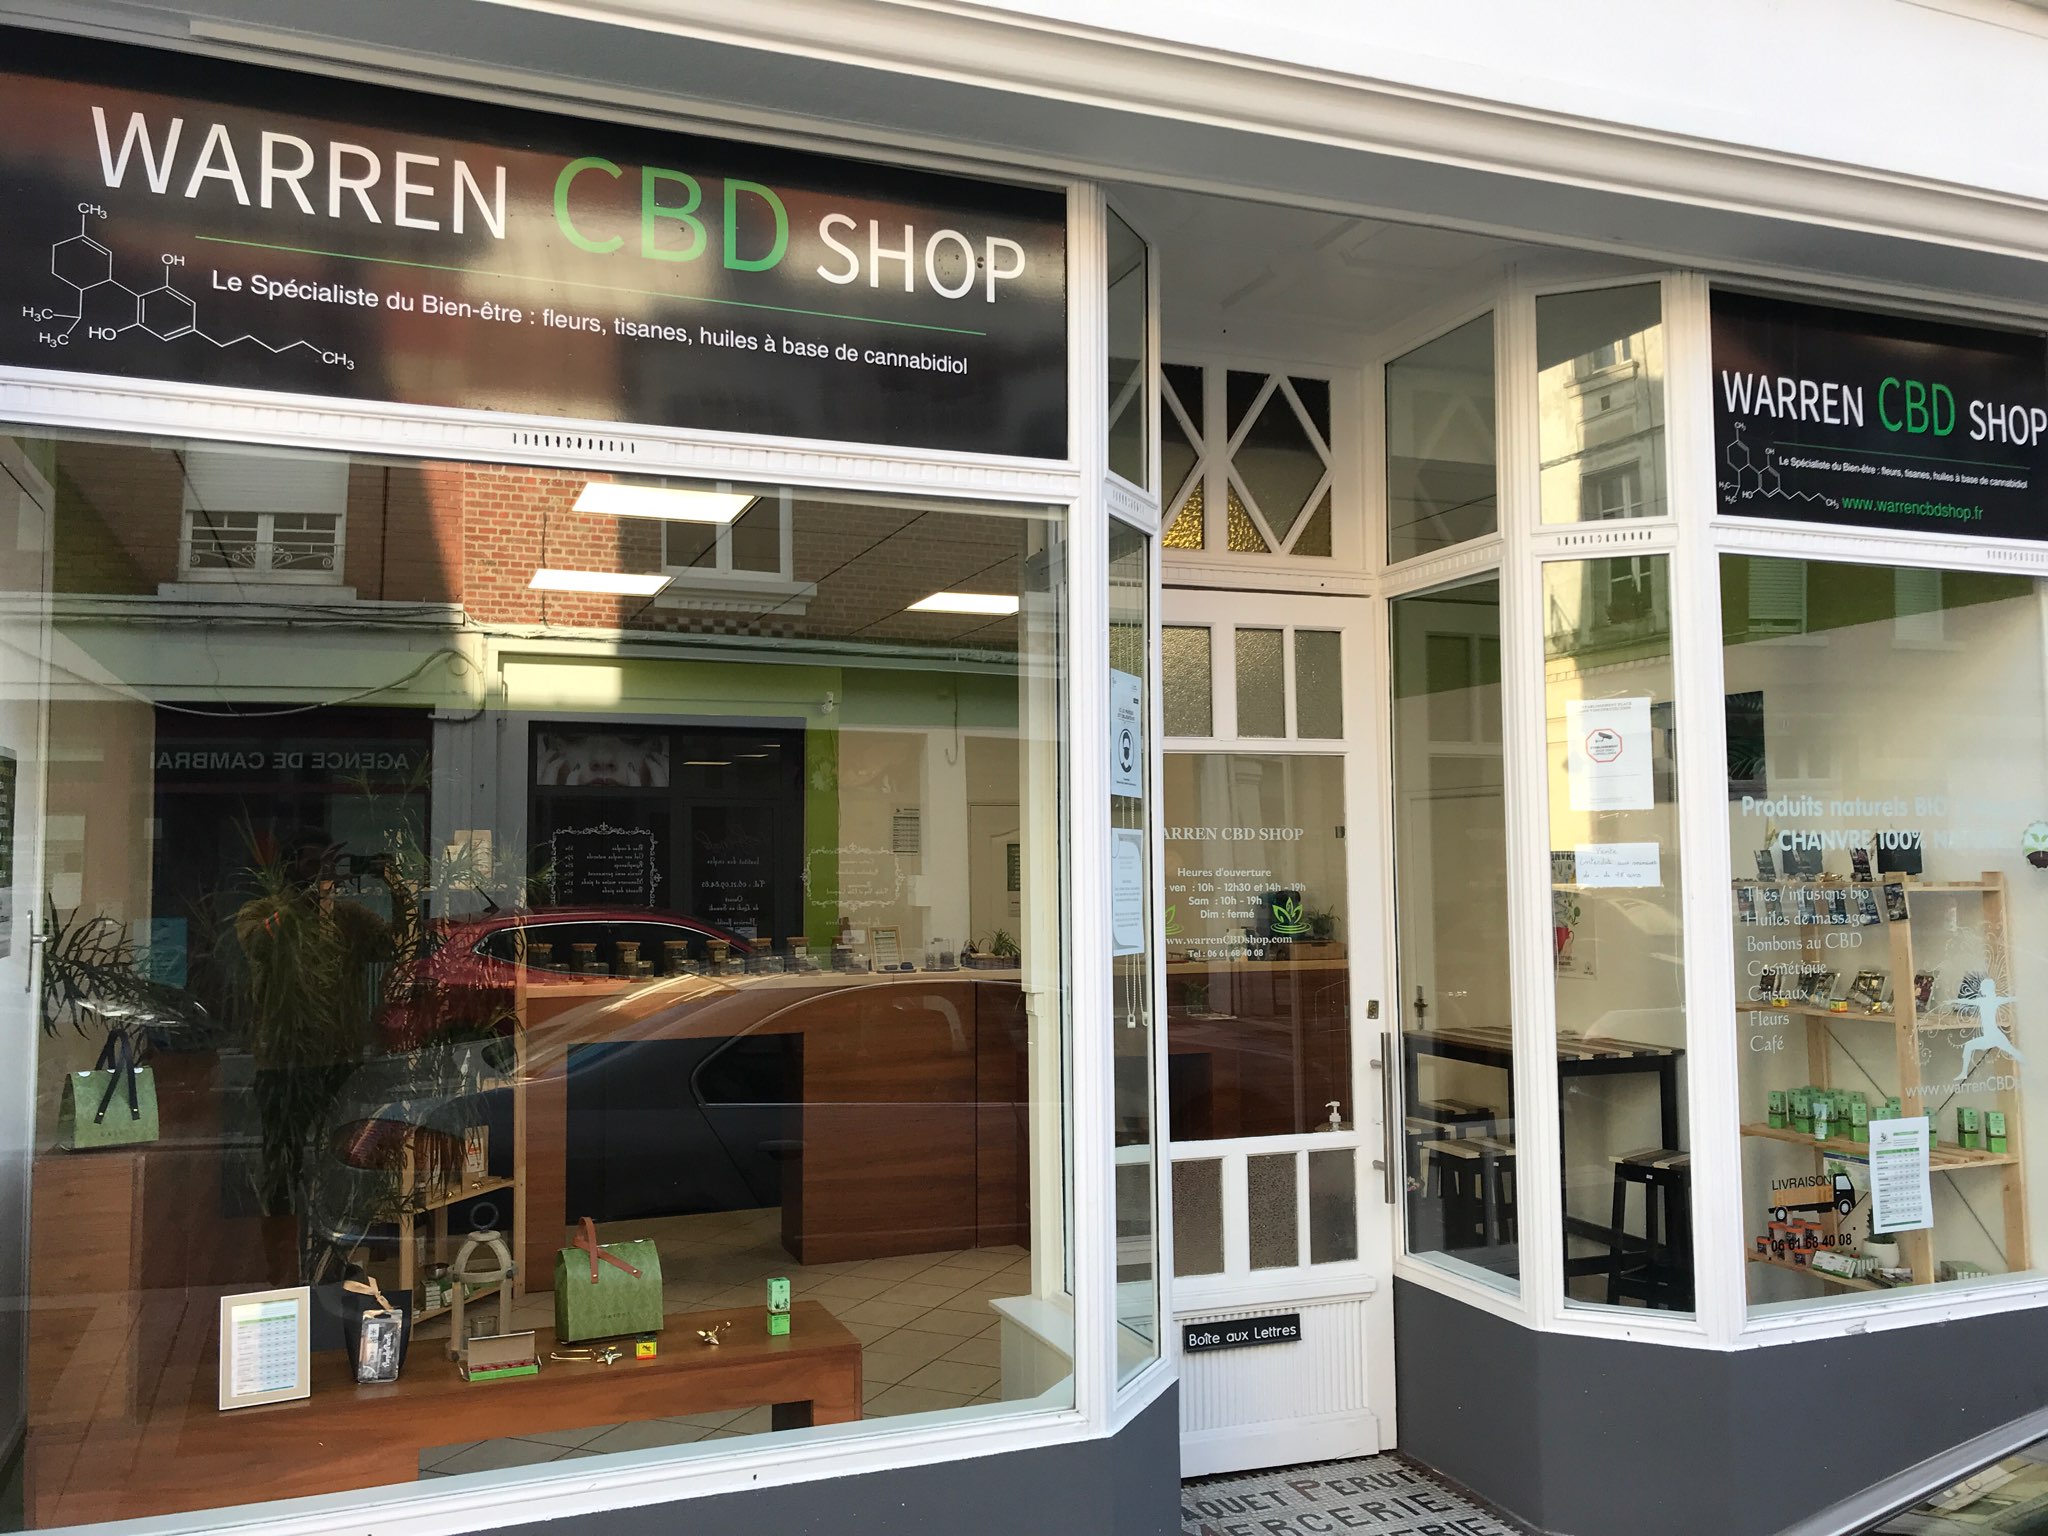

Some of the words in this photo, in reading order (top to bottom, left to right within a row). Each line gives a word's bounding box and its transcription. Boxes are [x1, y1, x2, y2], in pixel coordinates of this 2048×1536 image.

[91, 105, 506, 240] WARREN
[553, 156, 789, 273] CBD
[816, 212, 1026, 304] SHOP
[161, 253, 185, 267] OH
[212, 269, 242, 291] Le
[250, 274, 379, 308] Spécialiste
[386, 290, 415, 312] du
[422, 294, 522, 325] Bien-être
[542, 308, 607, 336] fleurs,
[614, 317, 693, 346] tisanes,
[700, 326, 758, 353] huiles
[764, 333, 777, 354] à
[782, 337, 829, 360] base
[835, 342, 859, 363] de
[864, 347, 969, 376] cannabidiol
[89, 326, 117, 341] HO
[1722, 370, 1865, 428] WARREN
[1878, 377, 1956, 437] CBD
[1969, 400, 2047, 447] SHOP
[1778, 456, 1789, 466] Le
[1790, 456, 1831, 470] Spécialiste
[1831, 461, 1842, 471] du
[1842, 462, 1876, 474] Bien-être
[1933, 471, 1954, 482] huiles
[1961, 474, 1979, 485] base
[1979, 476, 1989, 486] de
[1989, 478, 2028, 489] cannabidiol
[1842, 497, 1984, 523] www.warrencbdshop.fr
[1741, 795, 1823, 818] Produits
[1829, 796, 1908, 818] naturels
[1163, 827, 1218, 841] ARREN
[1221, 827, 1256, 841] CBD
[1258, 827, 1305, 841] SHOP
[1778, 829, 1871, 850] CHANVRE
[1877, 829, 1927, 850] 100%
[1177, 867, 1213, 877] Heures
[1215, 867, 1272, 877] d'ouverture
[1169, 884, 1187, 892] ven
[1198, 883, 1214, 892] 10h
[1224, 883, 1251, 892] 12h30
[1253, 883, 1264, 892] et
[1265, 883, 1281, 892] 14h
[1291, 883, 1306, 892] 19h
[1744, 885, 1777, 902] Thés
[1789, 885, 1846, 901] infusions
[1850, 884, 1869, 900] bio
[1188, 897, 1209, 905] Sam
[1220, 896, 1237, 905] 10h
[1247, 896, 1263, 905] 19h
[1200, 910, 1219, 918] Dim
[1226, 909, 1255, 918] fermé
[1746, 911, 1790, 927] Huiles
[1793, 909, 1808, 925] de
[1811, 912, 1868, 928] massage
[1166, 935, 1293, 946] ww.warrenCBDshop.com
[1746, 934, 1803, 953] Bonbons
[1806, 937, 1822, 950] au
[1825, 932, 1863, 949] CBD
[1188, 950, 1201, 958] Tel
[1207, 950, 1218, 958] 06
[1219, 949, 1228, 957] 61
[1253, 949, 1264, 957] 08
[1747, 959, 1827, 978] Cosmétique
[1748, 984, 1810, 1003] Cristaux
[1749, 1010, 1791, 1027] Fleurs
[1750, 1034, 1785, 1054] Café
[1771, 1175, 1832, 1191] LIVRAISON
[1771, 1240, 1785, 1252] 06
[1789, 1238, 1802, 1250] 61
[1822, 1235, 1836, 1248] 40
[1839, 1233, 1853, 1246] 08
[1188, 1331, 1221, 1348] Boîte
[1226, 1329, 1249, 1343] aux
[1254, 1323, 1297, 1340] Lettres
[1181, 1490, 1289, 1522] AQUET
[1286, 1469, 1418, 1503] PERUT
[1198, 1492, 1455, 1536] ERCERIE
